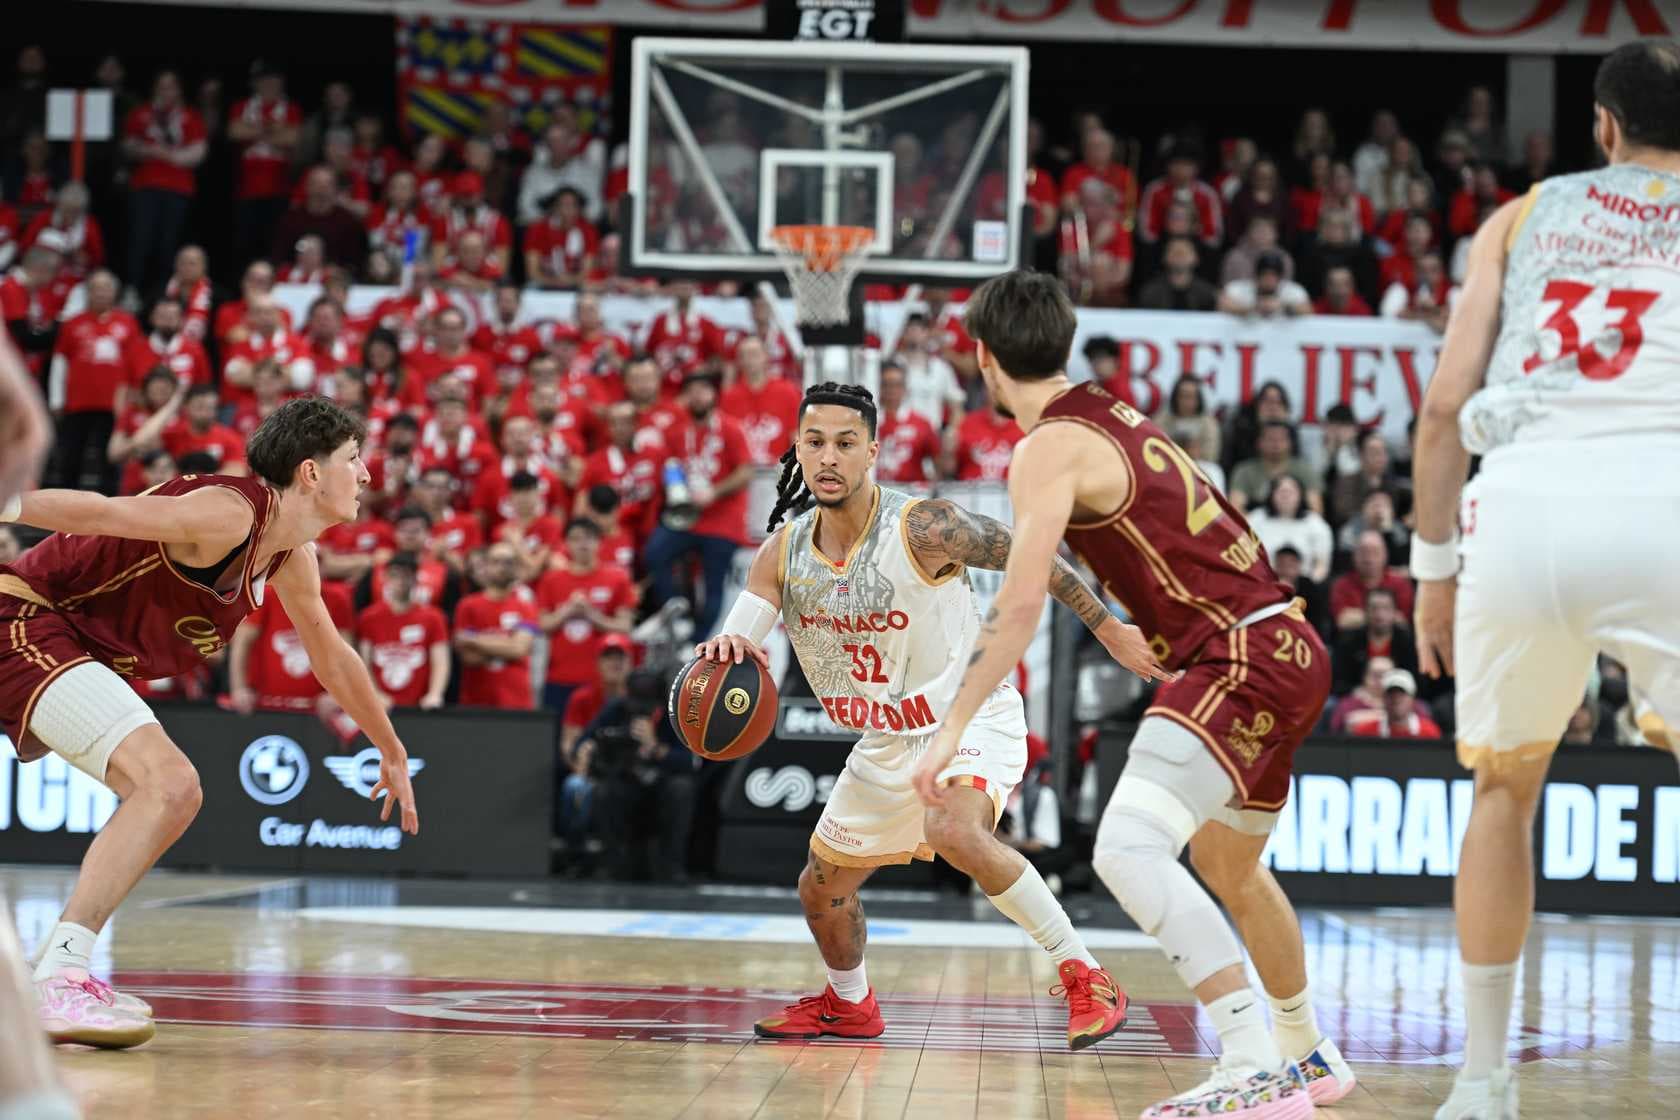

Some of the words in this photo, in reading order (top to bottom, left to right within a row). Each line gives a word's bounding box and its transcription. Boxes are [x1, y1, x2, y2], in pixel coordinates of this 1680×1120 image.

[799, 9, 875, 39] EGT
[1522, 279, 1662, 381] 33
[1115, 339, 1440, 430] BELIEV
[1142, 436, 1223, 536] 2
[799, 610, 909, 633] MONACO
[842, 644, 889, 683] 32
[1273, 628, 1312, 669] 20
[822, 695, 936, 731] FEDCOM
[260, 817, 304, 846] Car
[306, 819, 402, 849] Avenue
[1543, 783, 1639, 881] DE
